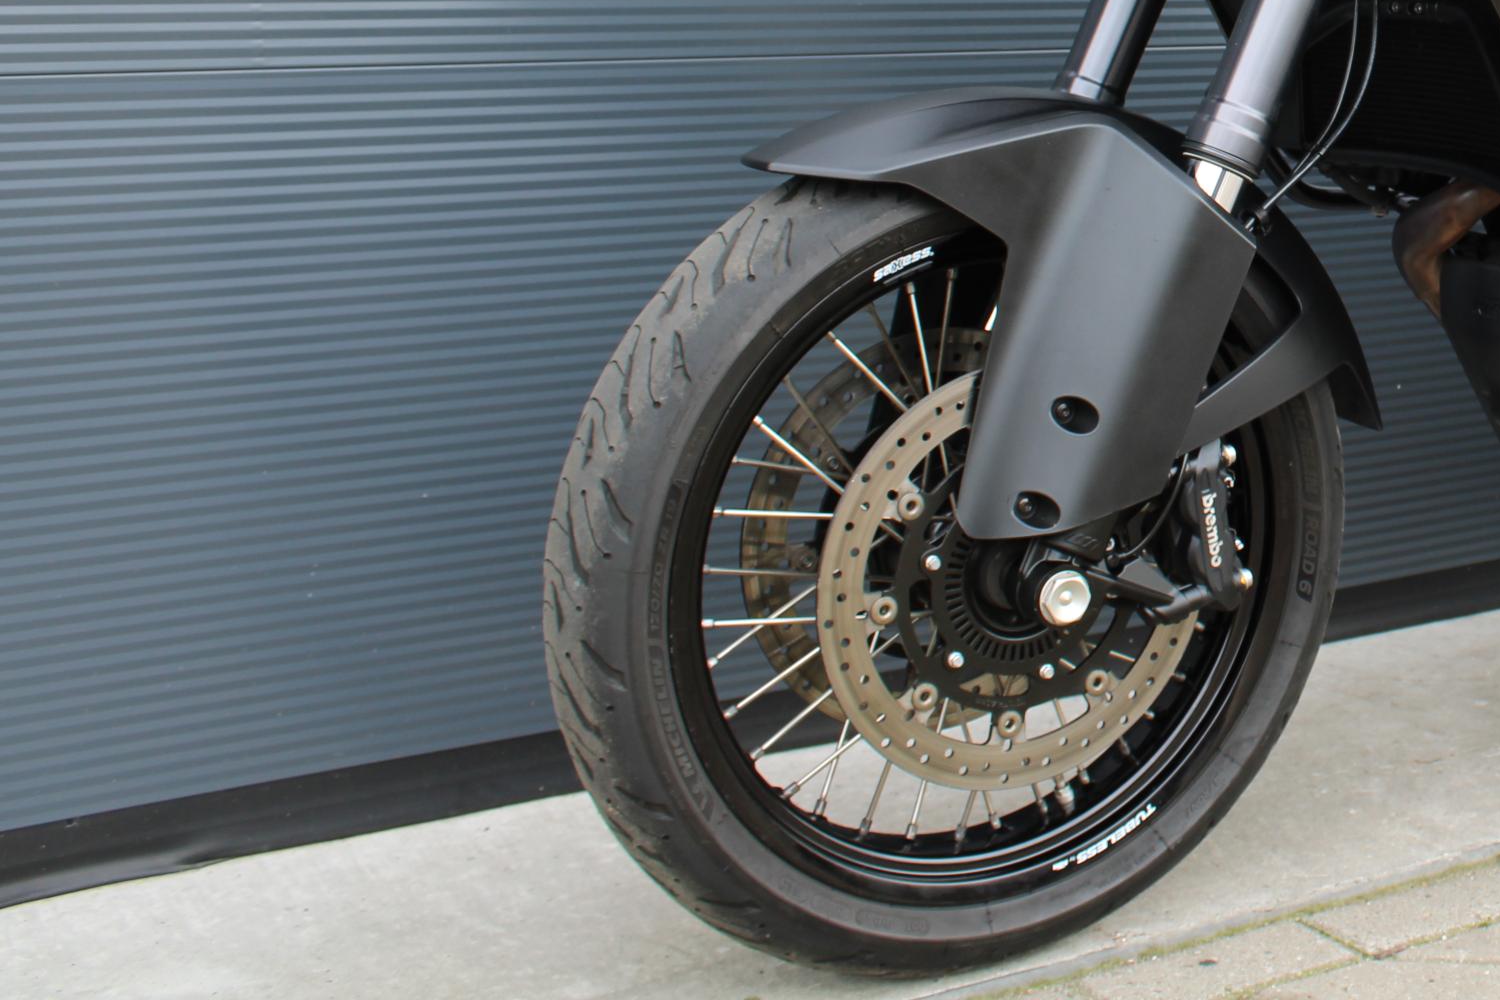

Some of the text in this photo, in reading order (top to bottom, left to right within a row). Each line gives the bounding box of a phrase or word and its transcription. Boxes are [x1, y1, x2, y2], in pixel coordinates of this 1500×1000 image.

[1202, 492, 1223, 568] brembo
[1301, 514, 1321, 576] ROAD
[1299, 578, 1312, 596] 6
[651, 652, 697, 780] MICHELIN
